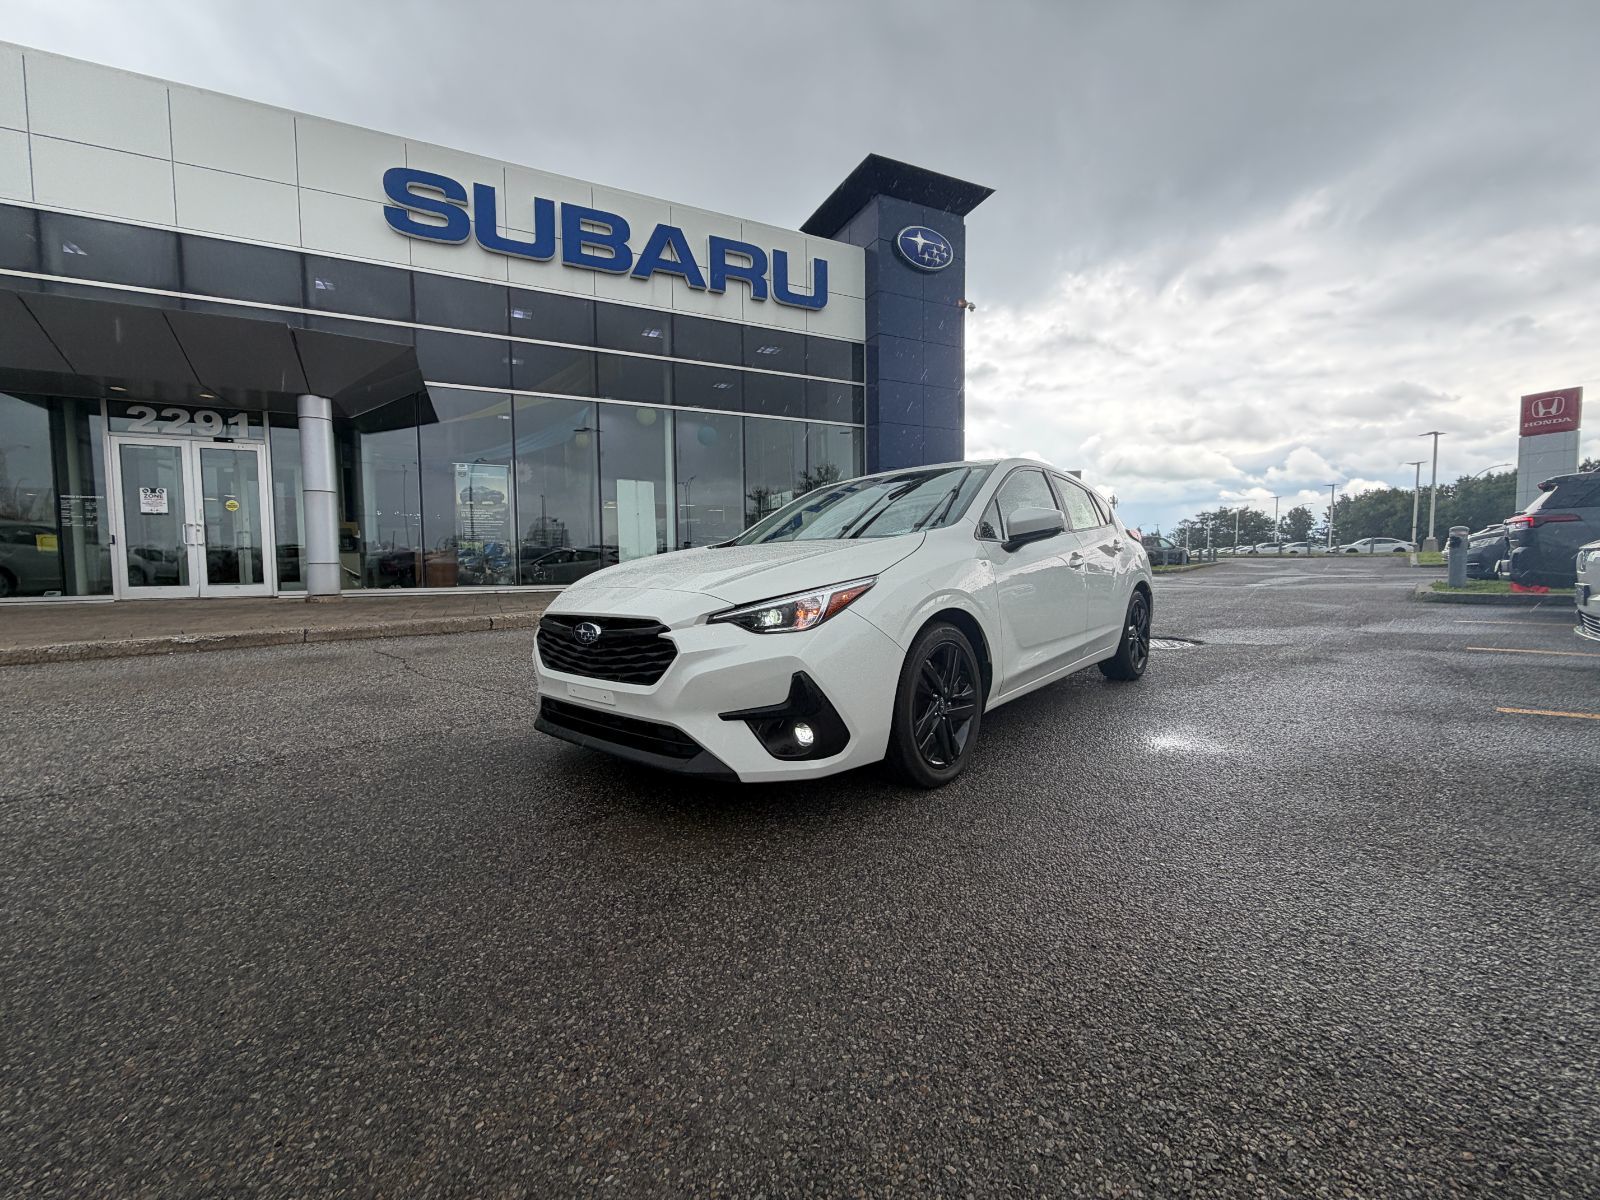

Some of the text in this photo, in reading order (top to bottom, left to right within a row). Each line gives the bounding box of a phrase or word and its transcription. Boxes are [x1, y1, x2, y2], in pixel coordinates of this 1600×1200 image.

[382, 167, 828, 311] SUBARU
[126, 405, 249, 438] 2291
[1524, 417, 1572, 428] HONDA
